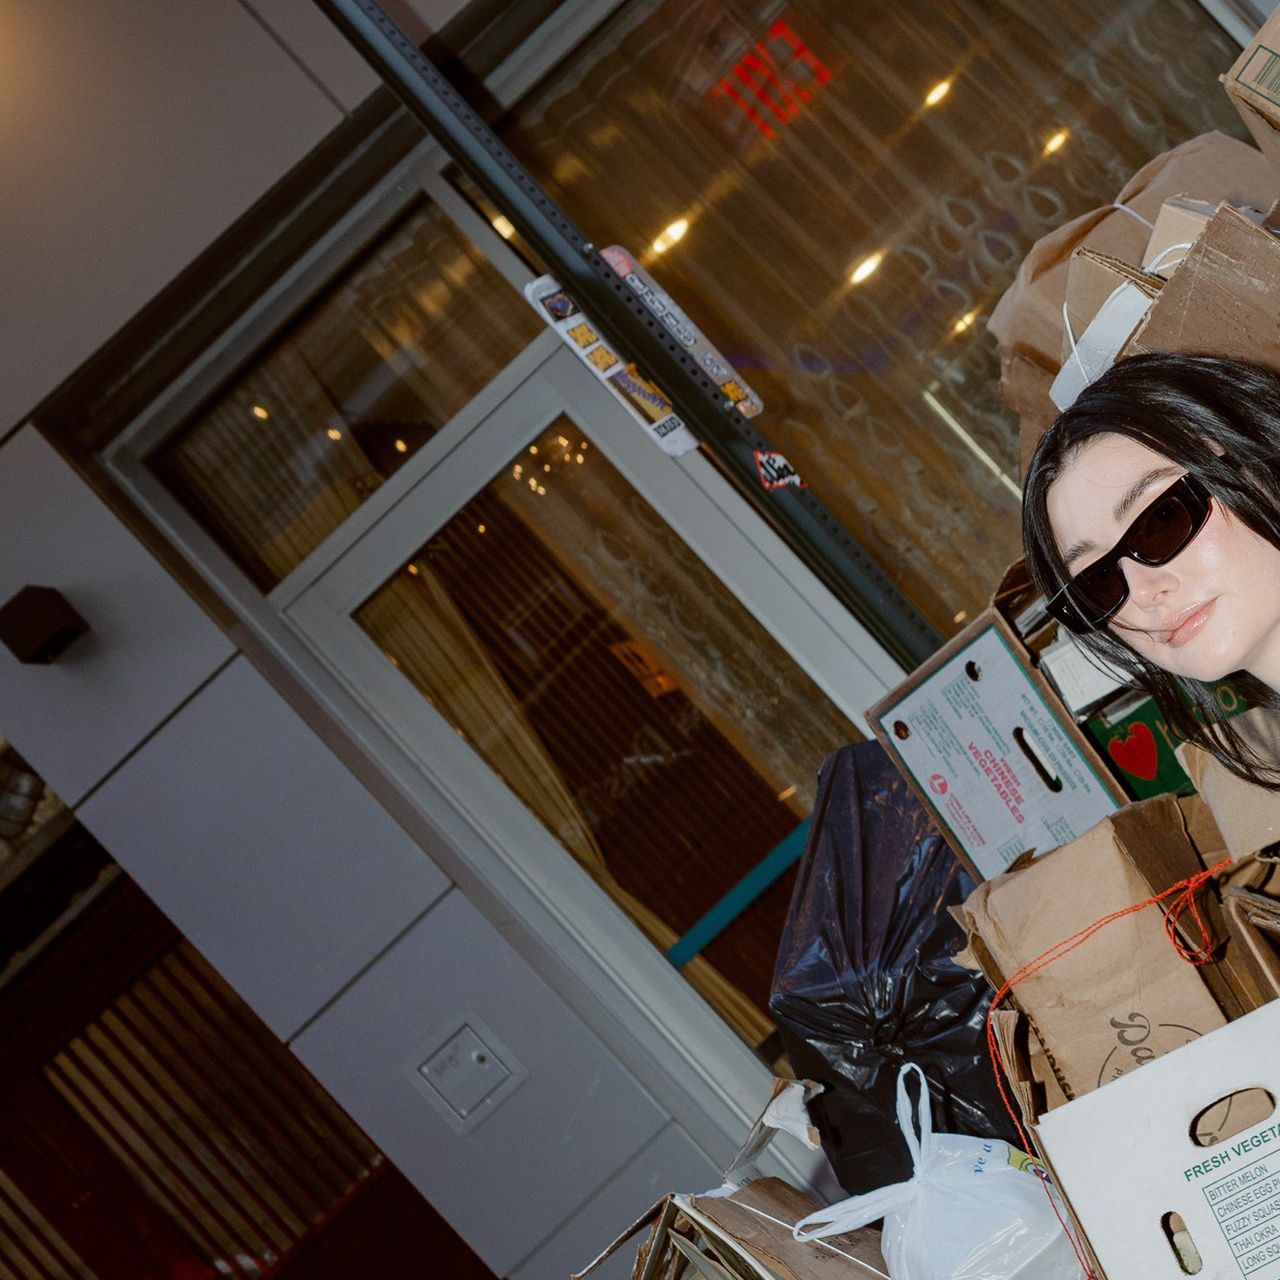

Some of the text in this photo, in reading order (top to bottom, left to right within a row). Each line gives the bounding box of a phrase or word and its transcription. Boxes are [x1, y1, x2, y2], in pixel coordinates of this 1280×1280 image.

[969, 742, 1024, 823] VEGETABLES
[981, 747, 1027, 808] CHINESE
[997, 758, 1020, 786] FRESH
[1184, 1151, 1230, 1181] FRESH
[1209, 1164, 1268, 1200] BITTER MELON
[1218, 1193, 1254, 1217] CHINESE
[1253, 1183, 1272, 1199] EGG
[1225, 1215, 1251, 1235] FUZZY
[1233, 1225, 1278, 1252] THAI OKRA
[1242, 1251, 1266, 1269] LONG
